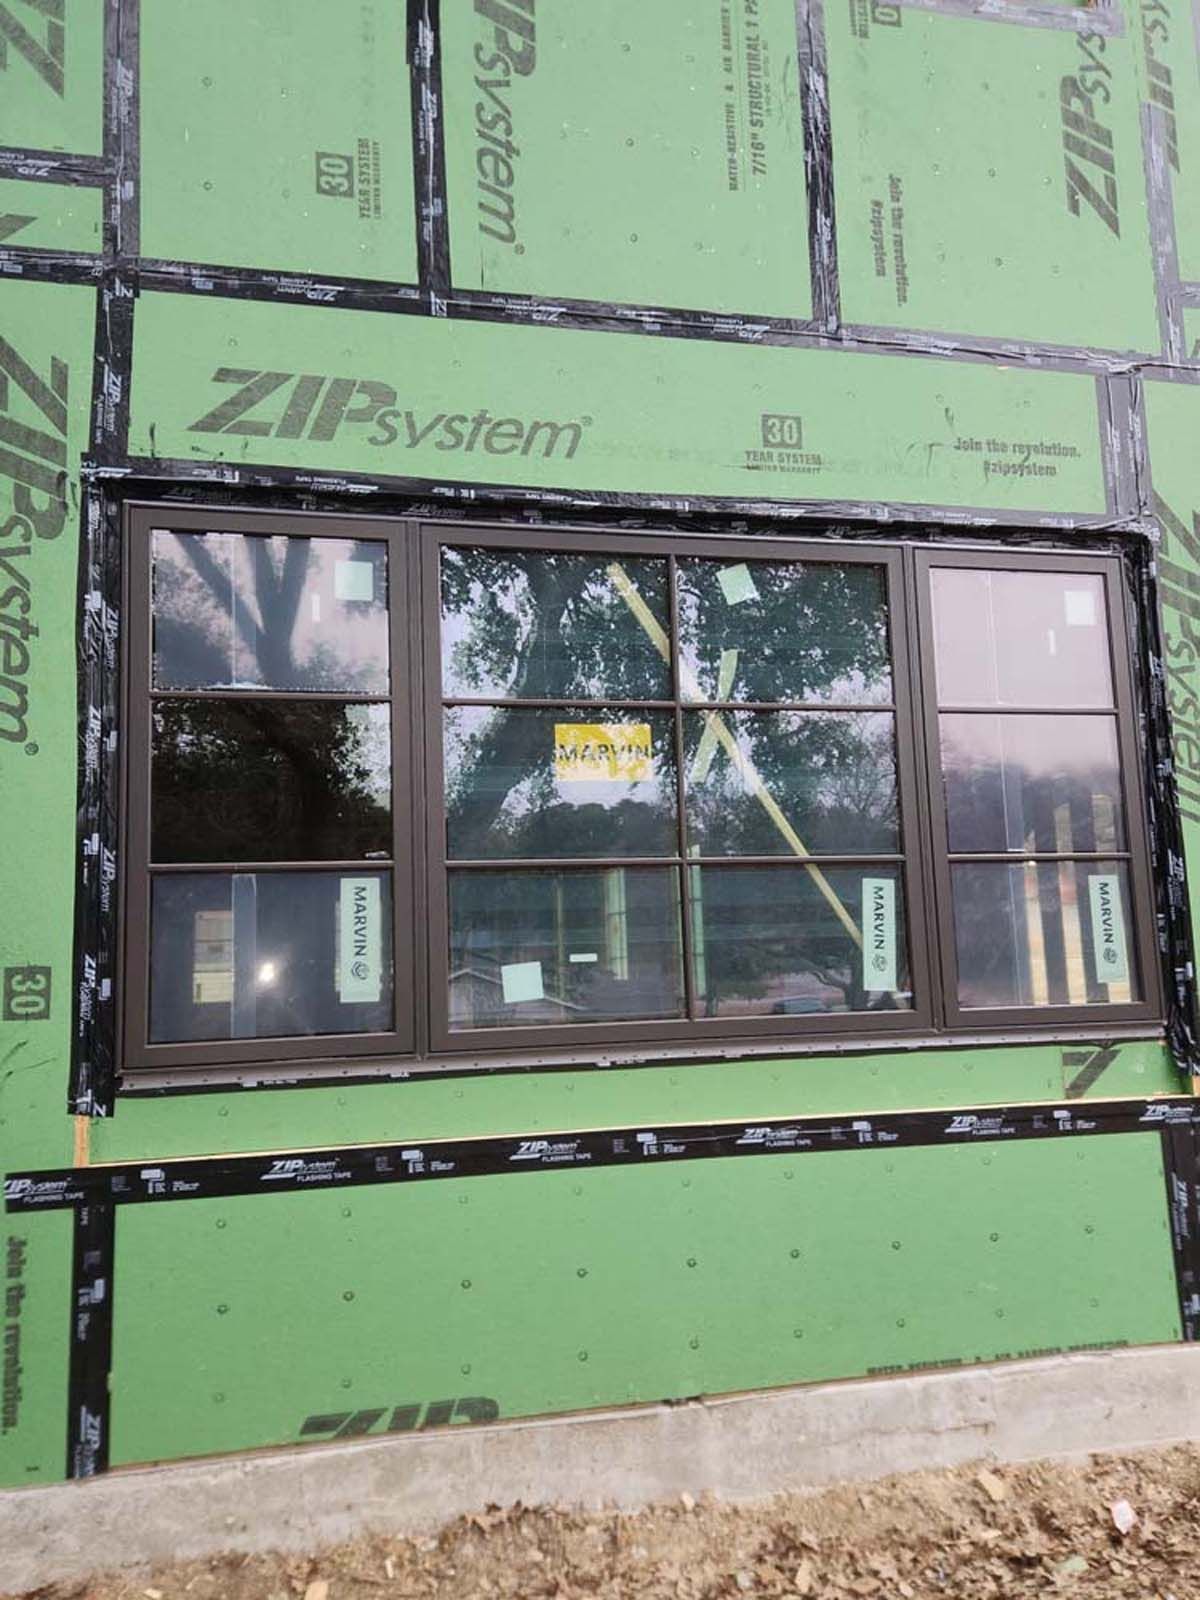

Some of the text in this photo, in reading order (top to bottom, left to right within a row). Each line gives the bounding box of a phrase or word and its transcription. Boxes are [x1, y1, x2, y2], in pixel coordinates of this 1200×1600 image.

[748, 32, 765, 130] STRUCTURAL
[319, 156, 351, 195] 30
[357, 138, 371, 184] SYSTEM
[752, 134, 768, 177] 7/16"
[765, 418, 799, 446] 30
[953, 436, 979, 452] Join
[982, 439, 1009, 452] the
[744, 449, 823, 466] YEAR SYSTEM
[556, 742, 652, 764] MARVIN
[353, 886, 368, 957] MARVIN
[872, 885, 885, 950] MARVIN
[1098, 881, 1115, 944] MARVIN
[10, 972, 47, 1015] 30
[6, 1234, 28, 1280] Join
[5, 1282, 26, 1320] the
